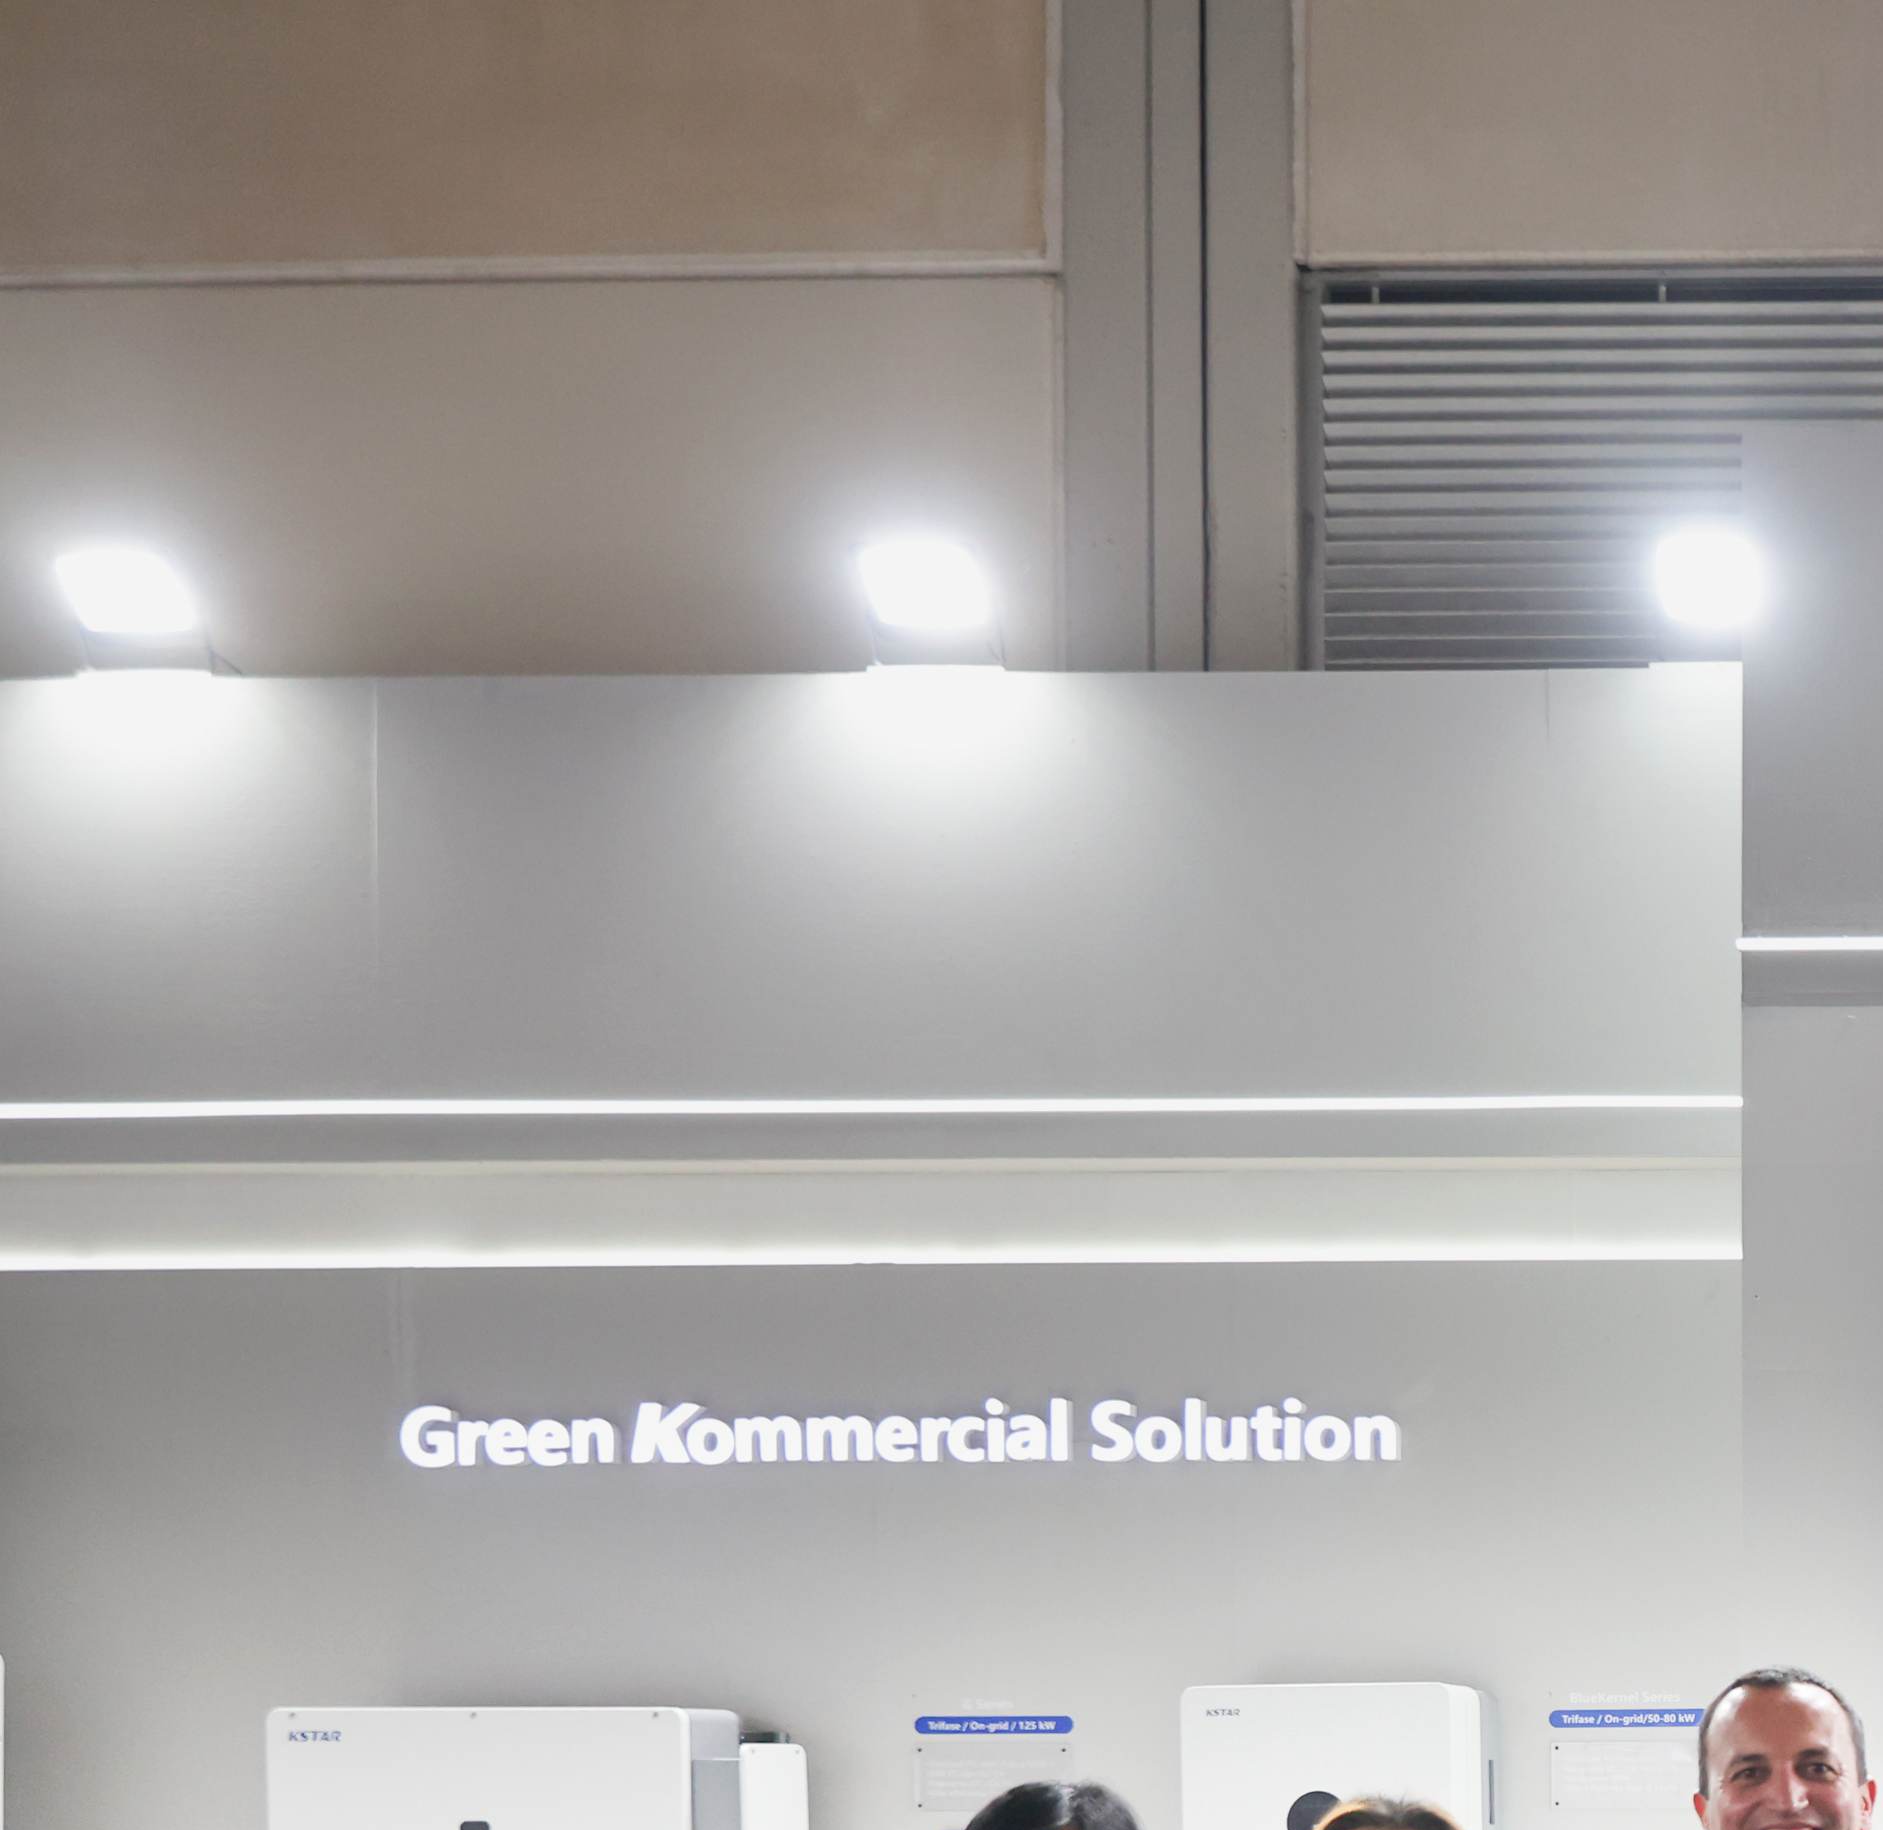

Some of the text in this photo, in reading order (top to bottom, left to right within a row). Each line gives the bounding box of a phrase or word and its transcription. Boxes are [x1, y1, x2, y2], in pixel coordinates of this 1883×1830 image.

[399, 1398, 1400, 1469] Green Kommercial Solution
[1561, 1714, 1595, 1725] Trifase
[1678, 1712, 1696, 1723] kW
[288, 1731, 343, 1742] KSTAR
